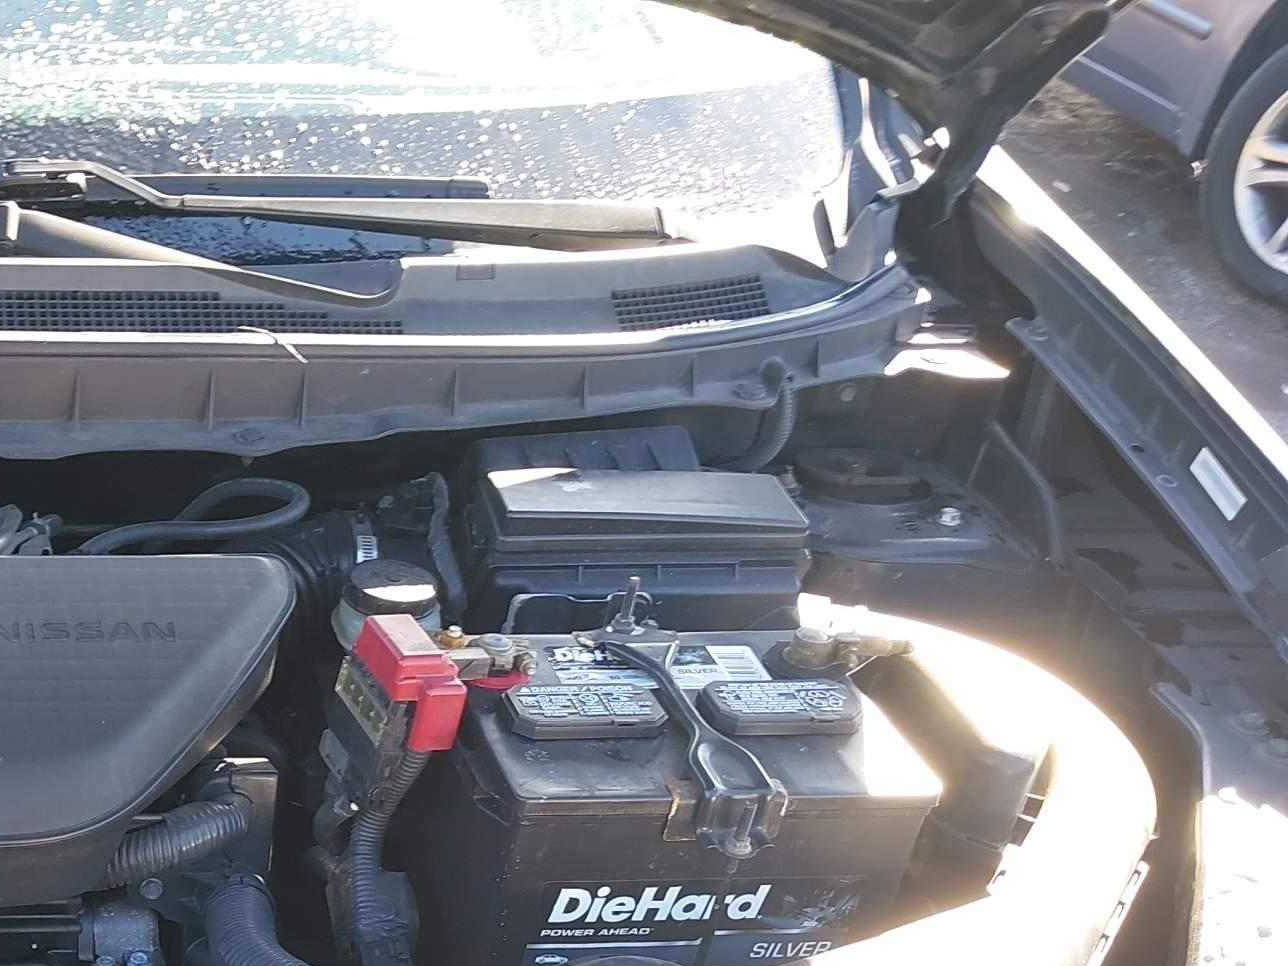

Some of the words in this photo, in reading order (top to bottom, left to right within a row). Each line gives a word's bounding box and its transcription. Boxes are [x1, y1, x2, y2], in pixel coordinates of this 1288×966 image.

[677, 667, 718, 675] SILVER
[548, 884, 772, 922] DieHard
[540, 929, 595, 937] POWER
[598, 927, 651, 936] AHEAD
[749, 941, 832, 958] SILVER
